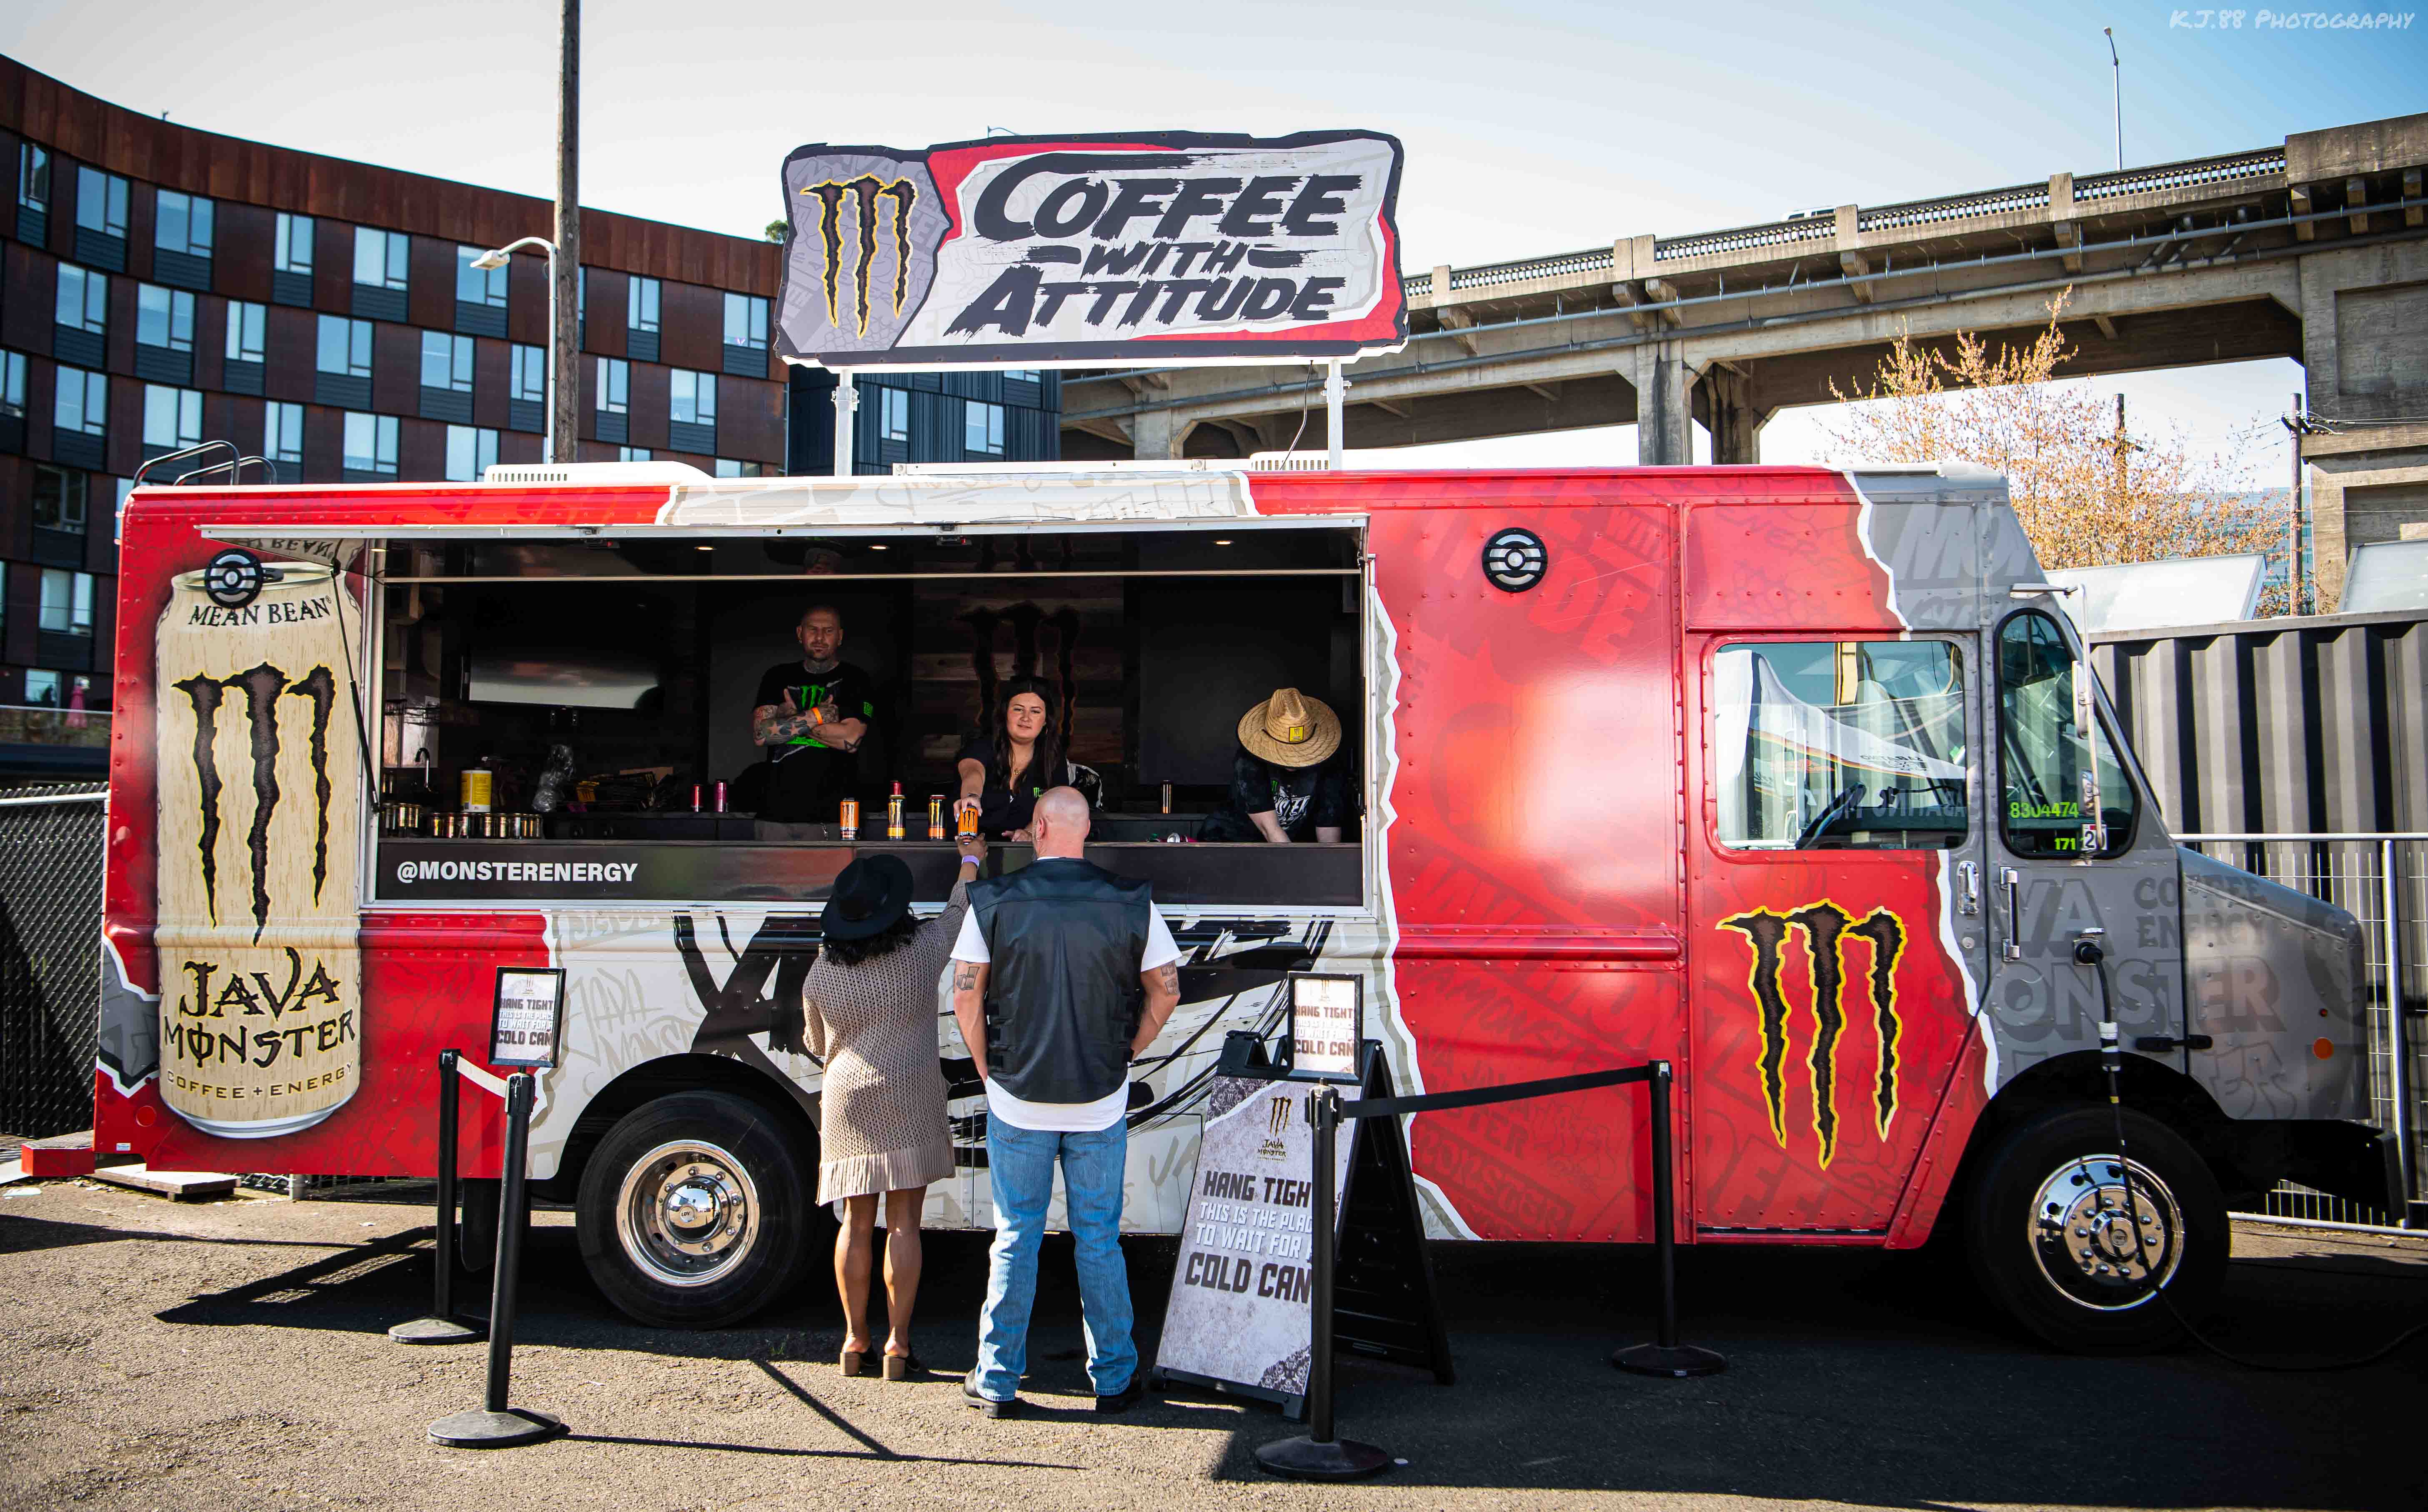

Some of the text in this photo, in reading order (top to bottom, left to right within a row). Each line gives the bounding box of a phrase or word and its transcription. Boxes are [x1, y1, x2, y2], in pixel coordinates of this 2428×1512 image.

[972, 153, 1363, 243] COFFEE
[1079, 240, 1249, 277] WITH
[942, 265, 1348, 338] ATTITUDE
[188, 605, 260, 626] MEAN
[397, 861, 638, 883] @MONSTERENERGY
[180, 946, 340, 1021] JAVA
[500, 999, 524, 1009] HANG
[500, 1010, 513, 1019] THIS
[1294, 1005, 1320, 1017] HANG
[500, 1020, 508, 1028] TO
[510, 1020, 530, 1029] WAIT
[533, 1021, 547, 1029] FOR
[164, 1008, 356, 1069] MONSTER
[497, 1030, 552, 1047] COLD CAN
[1294, 1039, 1354, 1056] COLD CAN
[1262, 1137, 1284, 1149] JAVA
[1203, 1170, 1312, 1208] HANG TIGH
[1200, 1202, 1312, 1234] THIS IS THE PLA
[1196, 1222, 1217, 1247] TO
[1221, 1226, 1267, 1254] WAIT
[1269, 1233, 1303, 1259] FOR
[1185, 1252, 1312, 1304] COLD CAN
